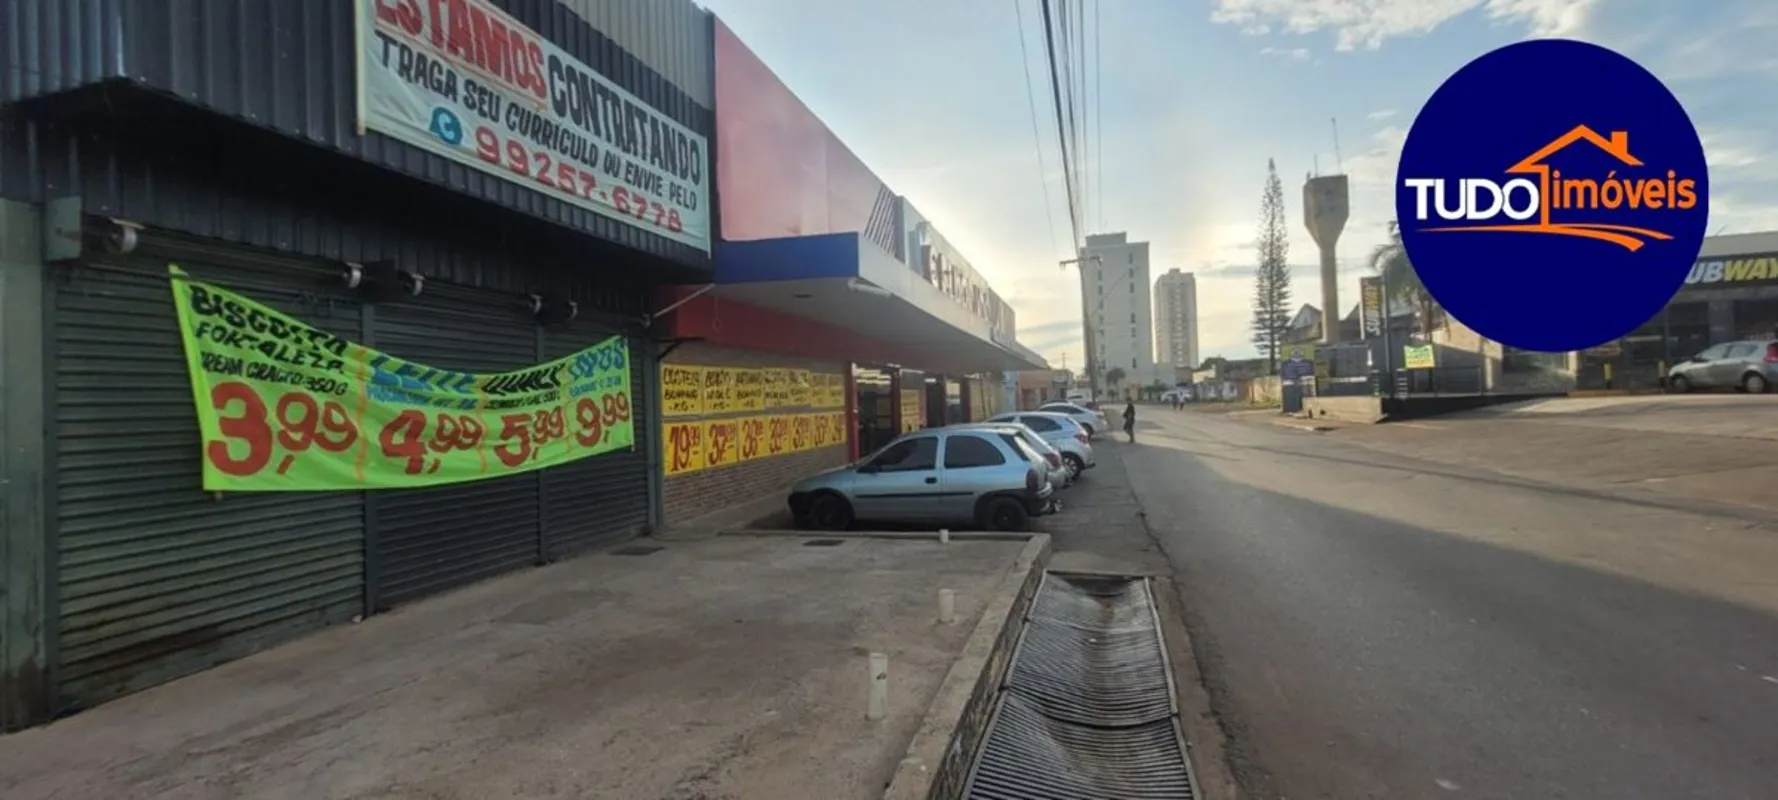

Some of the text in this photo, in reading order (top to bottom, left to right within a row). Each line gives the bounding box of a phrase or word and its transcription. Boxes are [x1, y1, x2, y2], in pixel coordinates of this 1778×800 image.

[374, 30, 457, 104] TRAGA
[463, 78, 500, 123] SEU
[603, 151, 620, 178] OU
[624, 163, 663, 198] ENVIE
[669, 182, 697, 212] PELO
[548, 54, 700, 187] CONTRATANDO
[1685, 259, 1778, 285] UBWAY
[207, 381, 358, 476] 3,99
[379, 409, 483, 475] 4,99
[494, 405, 565, 467] 5,99
[575, 391, 630, 448] 9,99
